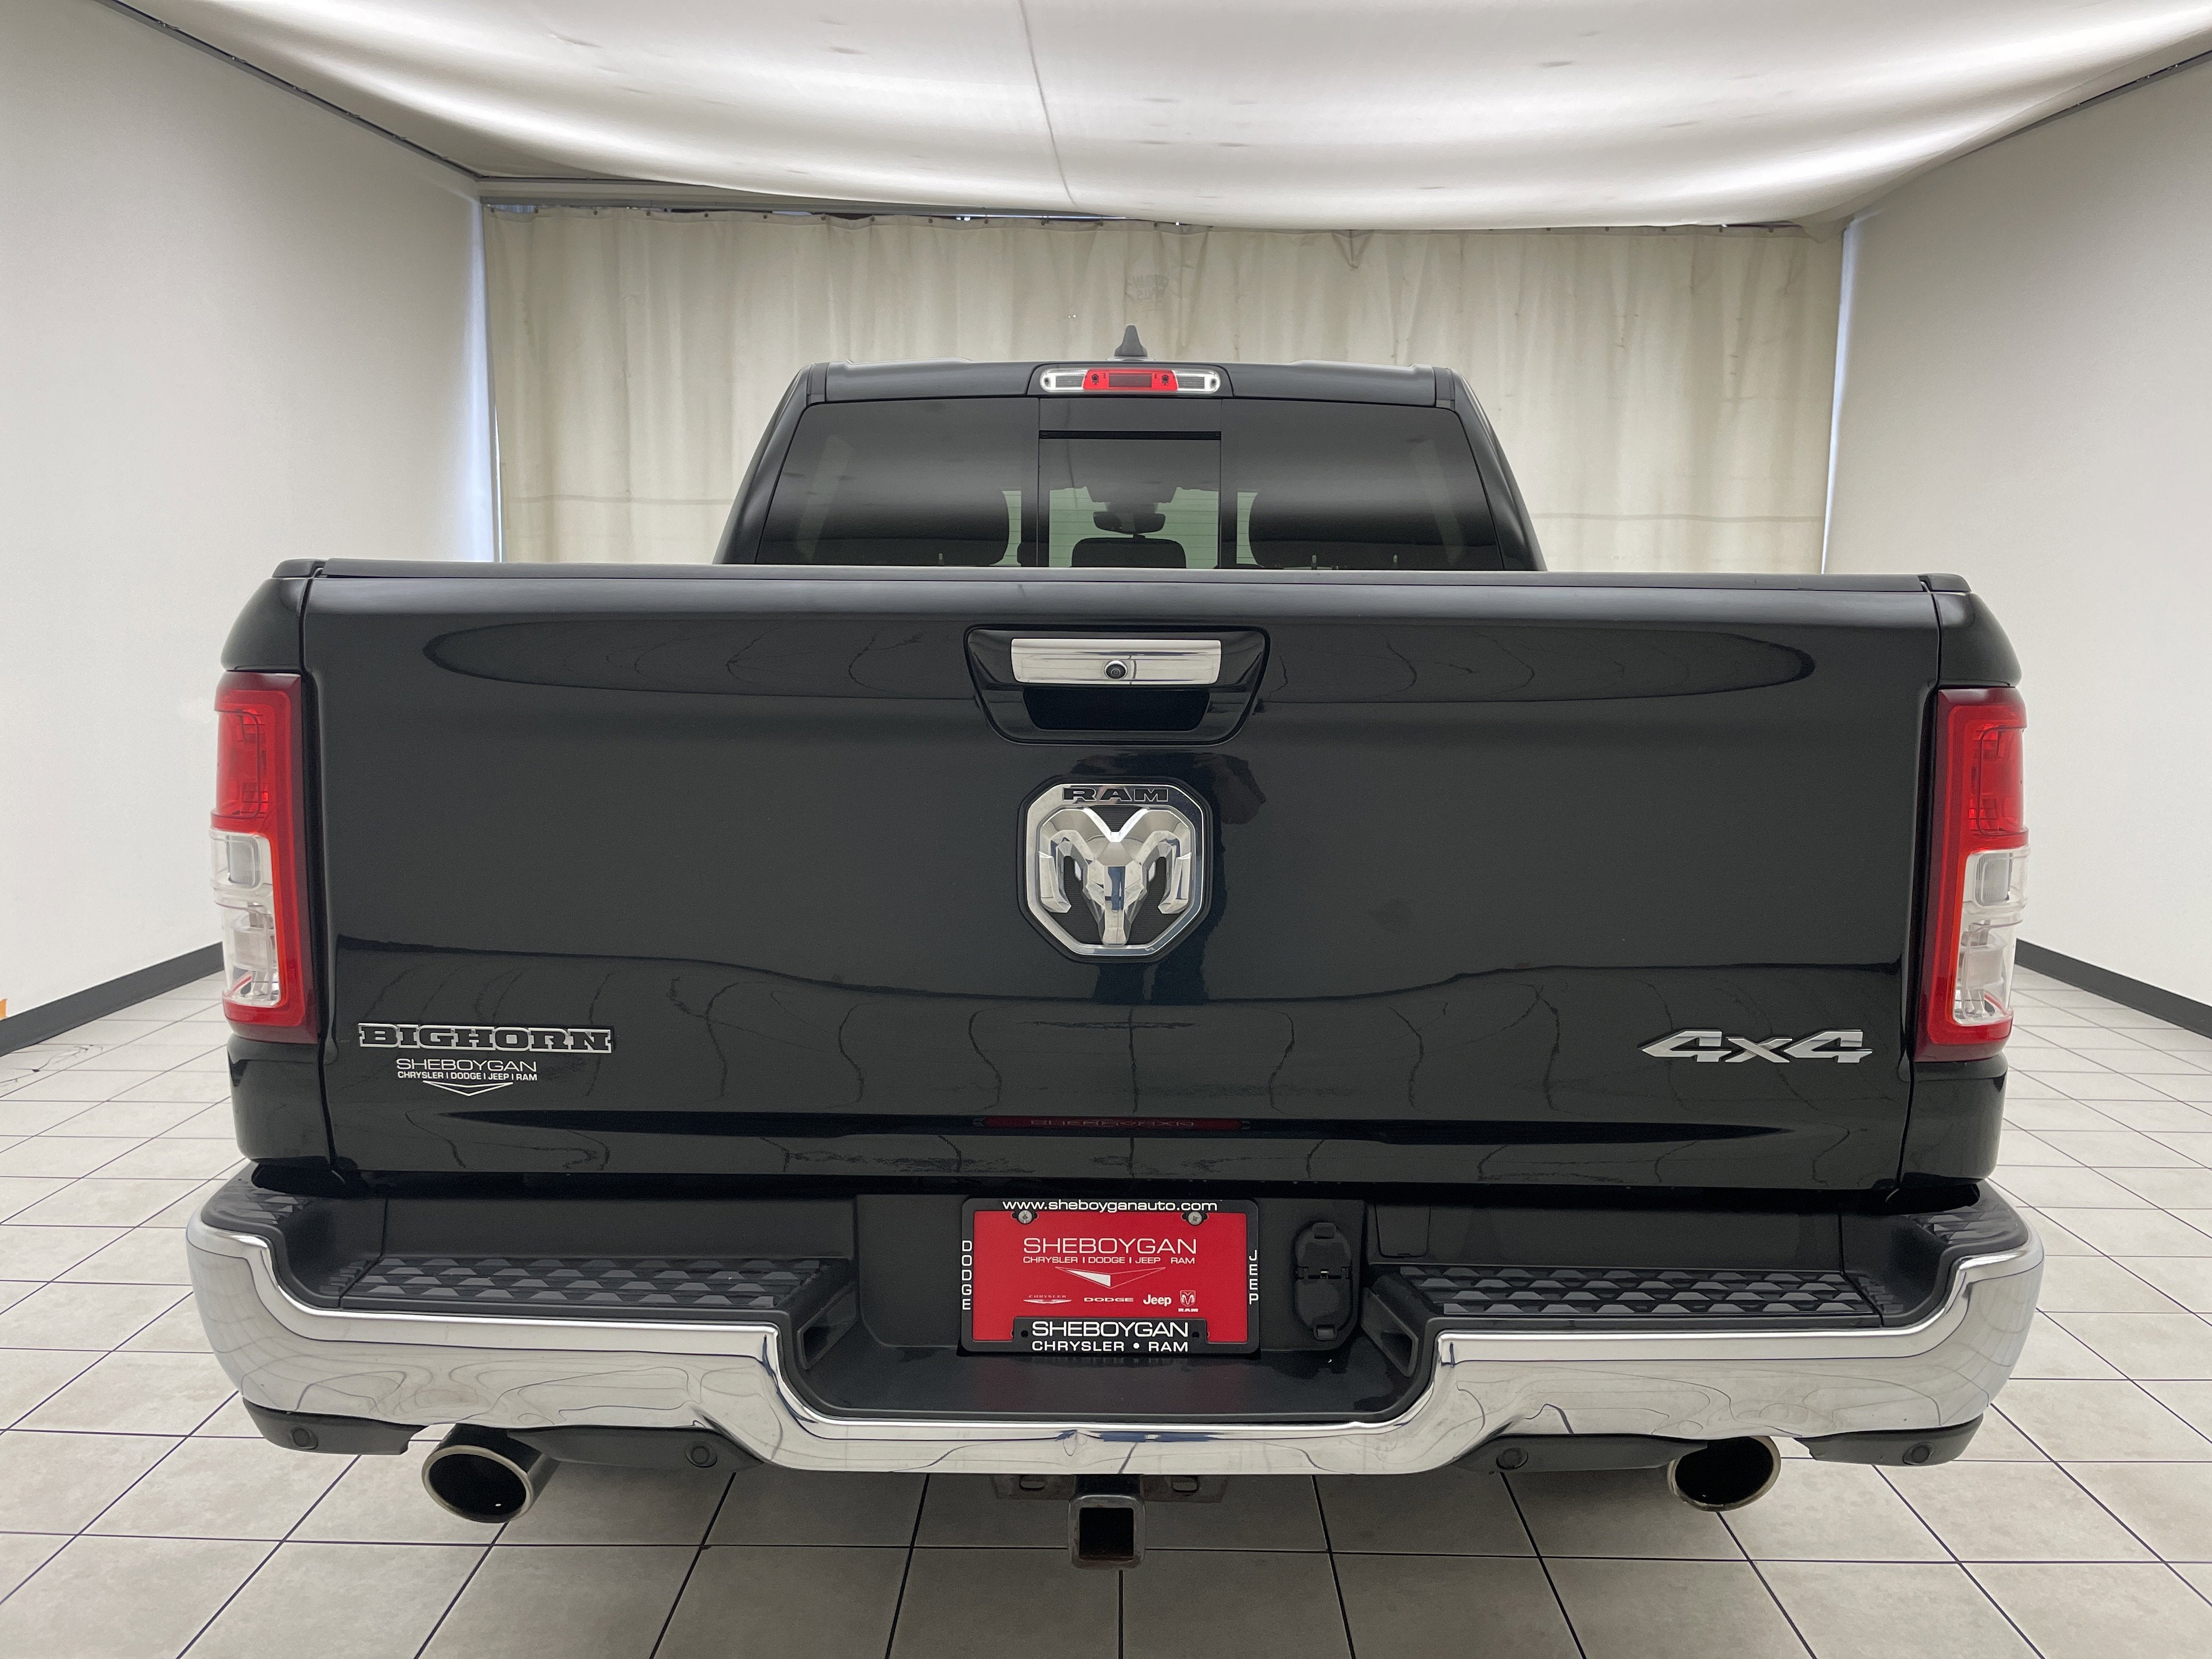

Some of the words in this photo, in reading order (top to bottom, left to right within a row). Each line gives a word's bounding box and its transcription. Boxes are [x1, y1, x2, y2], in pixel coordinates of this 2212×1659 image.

[1063, 787, 1169, 802] RAM
[358, 1023, 612, 1053] BIGHORN
[396, 1058, 537, 1072] SHEBOYGAN
[397, 1071, 444, 1079] CHRYSLER
[1002, 1199, 1218, 1213] www.sheboyganauto.com
[1023, 1238, 1197, 1255] SHEBOYGAN
[962, 1240, 972, 1310] DODGE
[1249, 1250, 1259, 1305] JEEP
[1143, 1294, 1172, 1307] Jeep
[1032, 1321, 1188, 1338] SHEBOYGAN
[1032, 1341, 1125, 1352] CHRYSLER
[1148, 1342, 1188, 1352] RAM
